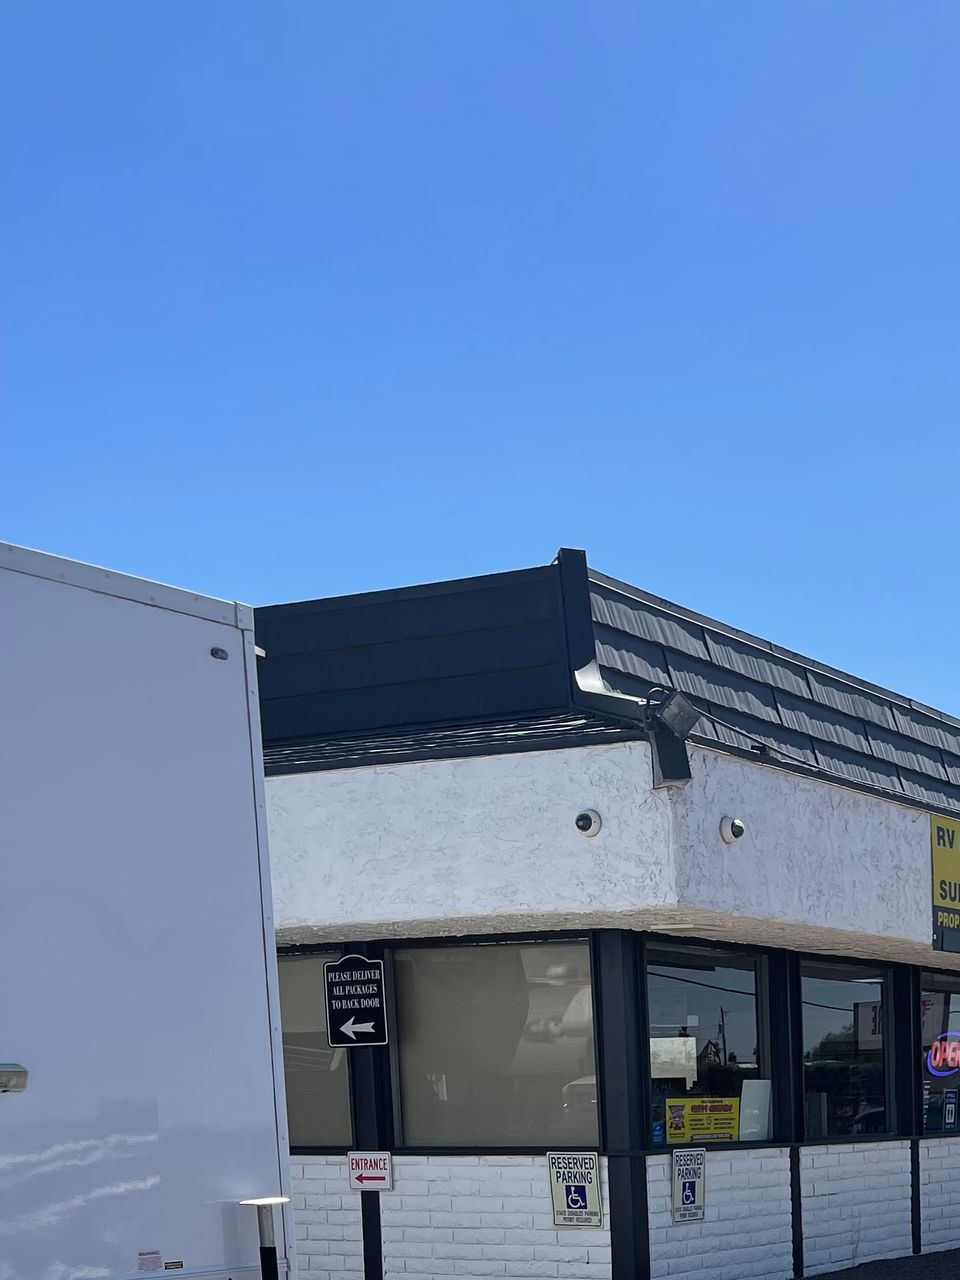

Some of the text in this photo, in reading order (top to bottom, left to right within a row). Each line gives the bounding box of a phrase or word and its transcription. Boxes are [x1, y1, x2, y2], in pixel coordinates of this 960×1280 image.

[936, 826, 955, 849] RV
[328, 970, 380, 981] PLEASE DELIVER
[332, 984, 377, 996] ALL PACKAGES
[332, 998, 380, 1009] TO BACK DOOR
[351, 1158, 388, 1170] ENTRANCE
[551, 1157, 594, 1170] RESERVED
[675, 1153, 703, 1167] RESERVED
[556, 1171, 593, 1184] PARKING
[677, 1167, 701, 1180] PARKING
